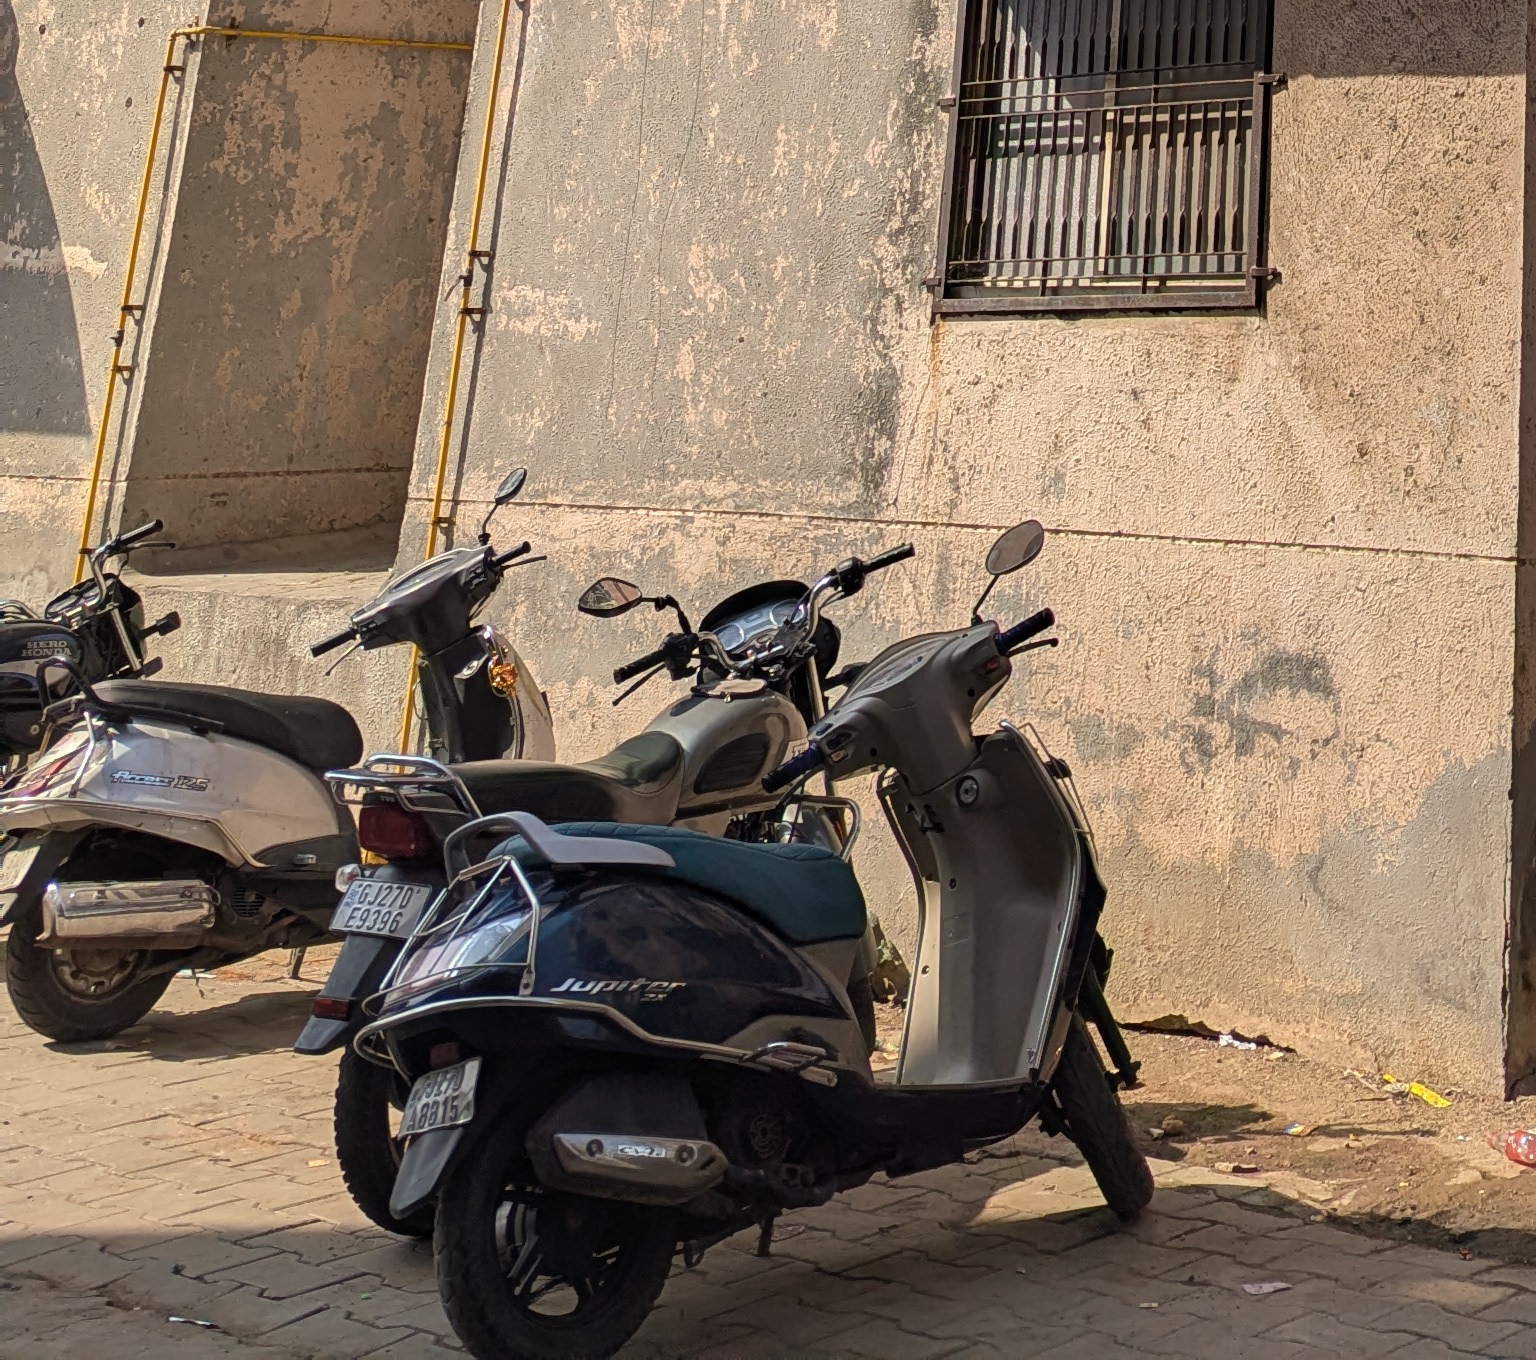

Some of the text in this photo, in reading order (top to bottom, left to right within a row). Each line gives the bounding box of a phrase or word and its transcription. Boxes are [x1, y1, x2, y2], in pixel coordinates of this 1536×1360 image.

[21, 648, 72, 657] HONDA
[26, 640, 68, 649] HERO
[110, 770, 210, 792] Access 125
[344, 906, 403, 934] E9396
[549, 977, 687, 995] Jupiter
